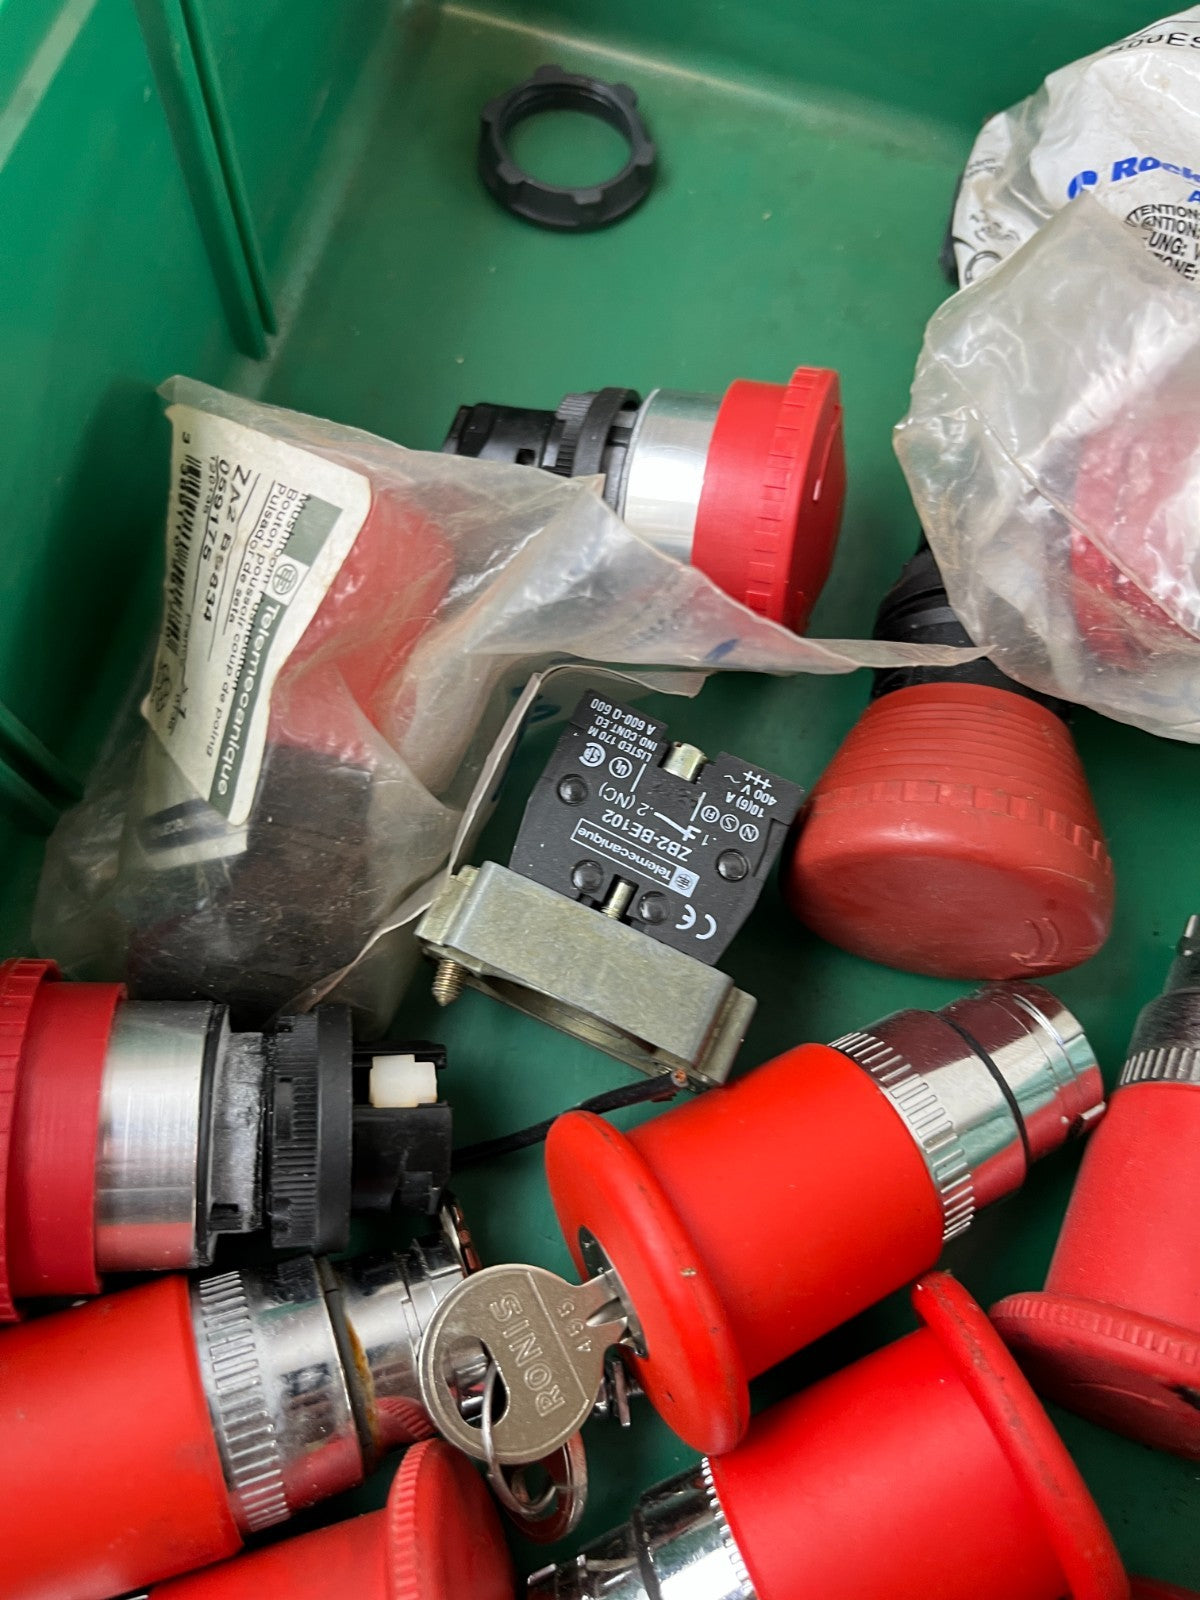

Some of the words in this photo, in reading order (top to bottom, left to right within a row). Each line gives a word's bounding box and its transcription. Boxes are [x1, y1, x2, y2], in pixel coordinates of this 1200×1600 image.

[1142, 231, 1187, 257] UNG:
[202, 458, 230, 562] 059175
[228, 465, 252, 523] ZA2
[248, 482, 287, 558] Pulsador
[262, 488, 300, 548] Bouton
[262, 493, 312, 584] Mushroom
[236, 553, 266, 626] poussoir
[240, 562, 253, 583] de
[228, 588, 244, 624] seta
[224, 634, 241, 677] coup
[217, 604, 281, 796] Telemecanique
[219, 682, 231, 703] de
[590, 698, 612, 715] 600
[206, 707, 224, 758] poing
[587, 726, 599, 737] M
[598, 731, 616, 745] 170
[646, 724, 656, 736] A
[617, 740, 652, 762] LISTED
[598, 781, 636, 810] (NC)
[725, 791, 736, 803] A
[735, 796, 764, 818] 10(6)
[740, 784, 751, 795] V
[753, 789, 778, 806] 400
[601, 809, 693, 862] ZB2-BE102
[576, 827, 672, 881] Telemecanique
[675, 904, 717, 940] CE
[489, 1293, 566, 1417] RONIS
